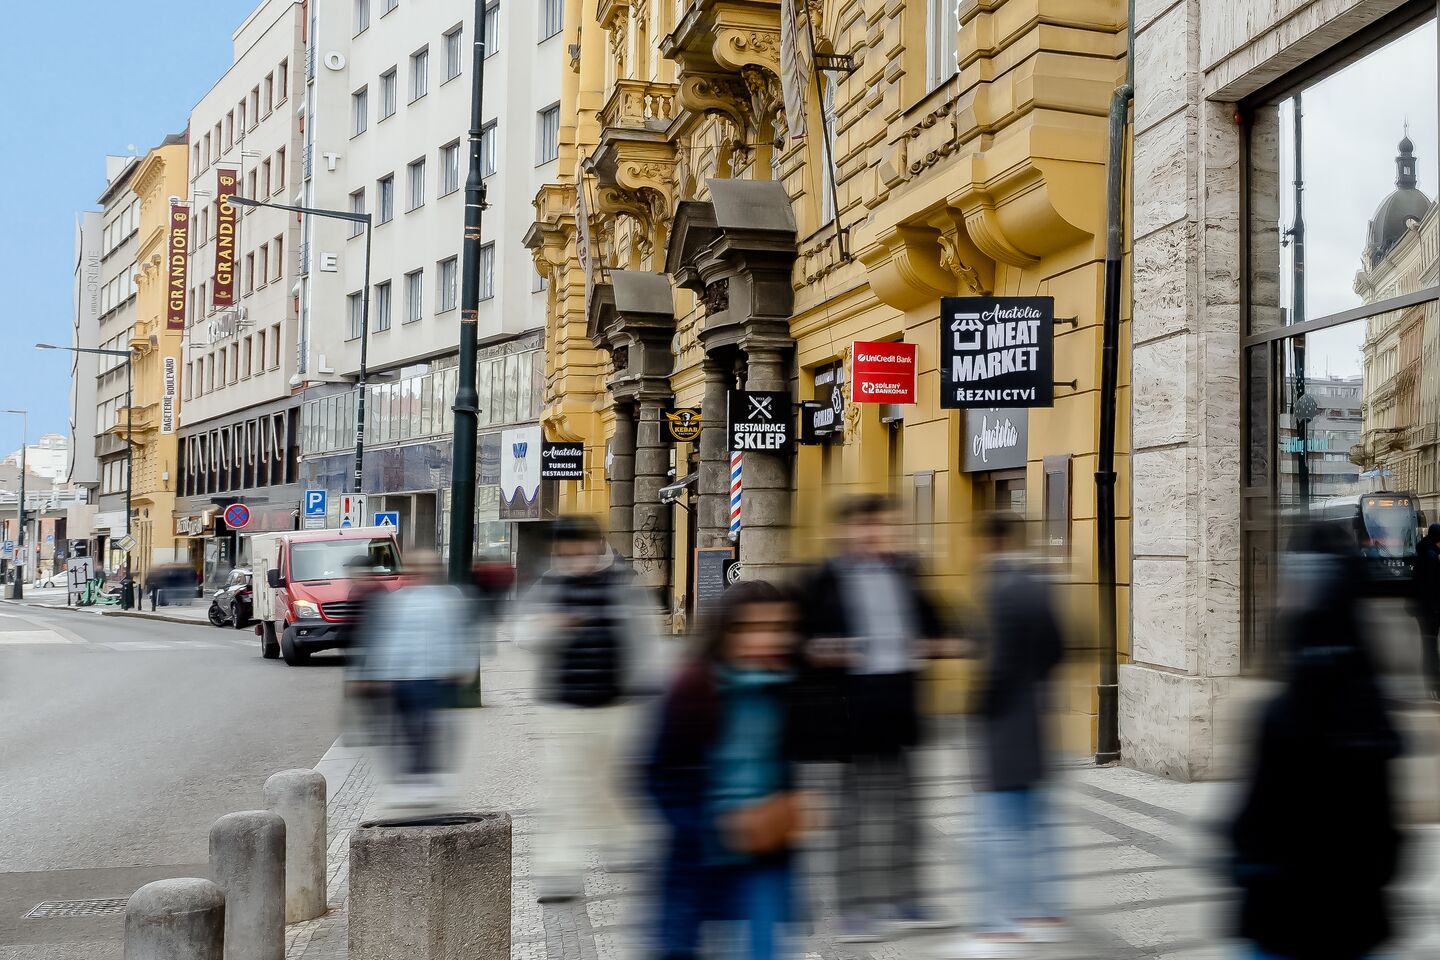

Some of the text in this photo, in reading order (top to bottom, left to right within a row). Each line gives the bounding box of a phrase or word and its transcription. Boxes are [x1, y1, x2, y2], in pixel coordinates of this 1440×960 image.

[217, 193, 234, 285] GRANDIOR
[170, 227, 187, 311] GRANDIOR
[981, 303, 1042, 324] Anatolia
[986, 320, 1041, 350] MEAT
[866, 354, 912, 364] UniCredit Bank
[952, 347, 1040, 382] MARKET
[165, 358, 175, 395] BOULEVARD
[956, 387, 1036, 401] ŘEZNICTVÍ
[734, 423, 786, 432] RESTAURACE
[734, 432, 786, 449] SKLEP
[973, 415, 1018, 462] Anatolia
[542, 446, 583, 459] Anatolia
[309, 492, 323, 509] P
